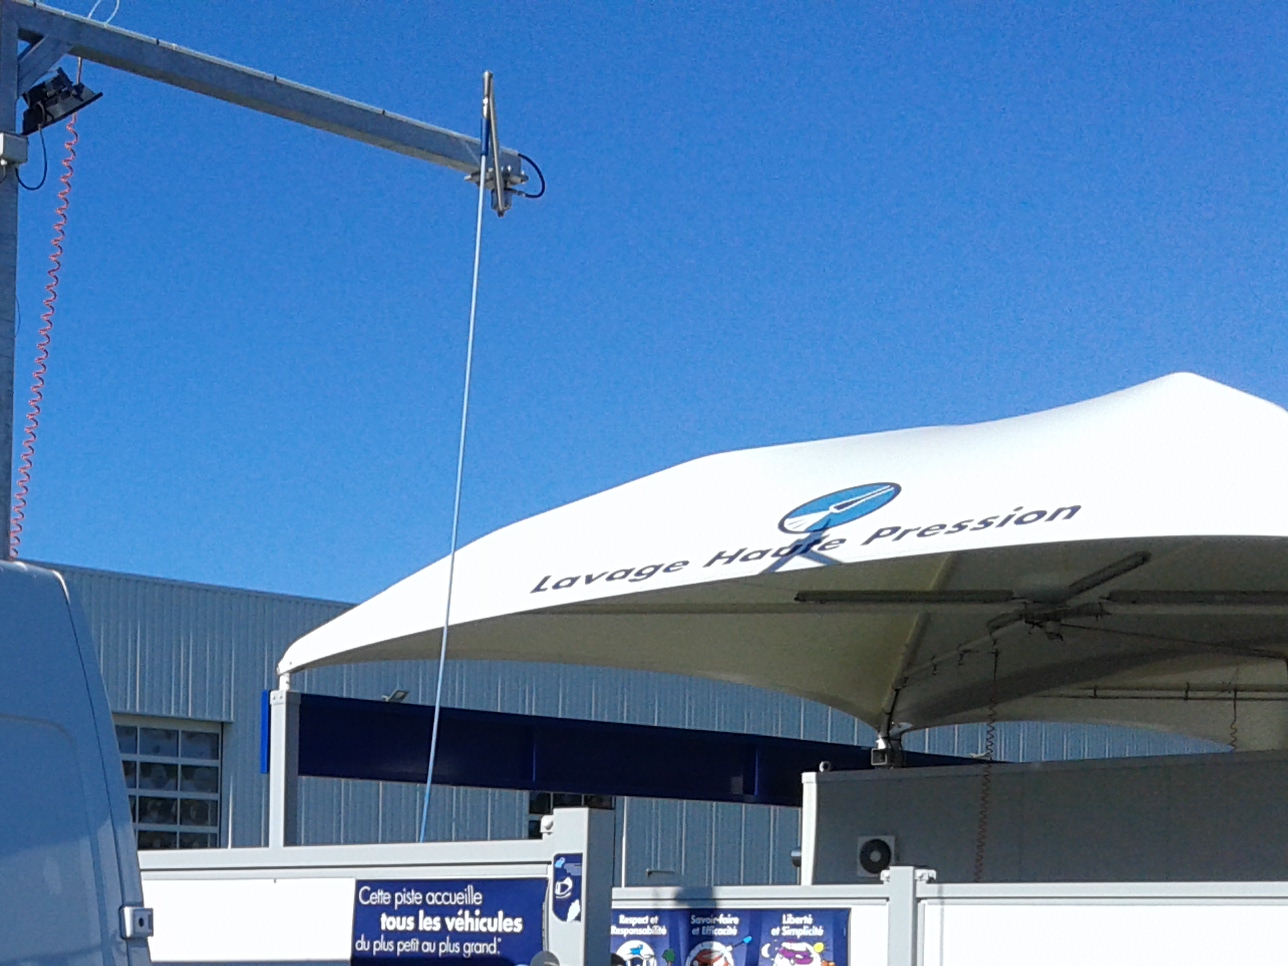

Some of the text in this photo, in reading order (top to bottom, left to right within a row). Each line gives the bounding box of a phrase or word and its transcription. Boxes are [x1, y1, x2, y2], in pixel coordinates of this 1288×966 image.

[531, 504, 1082, 594] Lavage Haute Pression
[358, 885, 483, 910] Cette piste accueille
[380, 909, 524, 933] tous les véhicules
[619, 914, 659, 927] Respect et
[782, 913, 813, 926] Liberté
[770, 925, 825, 939] et Simplicité
[355, 934, 370, 951] du
[373, 936, 394, 955] plus
[397, 938, 419, 956] petit
[421, 940, 436, 951] au
[439, 936, 460, 956] plus
